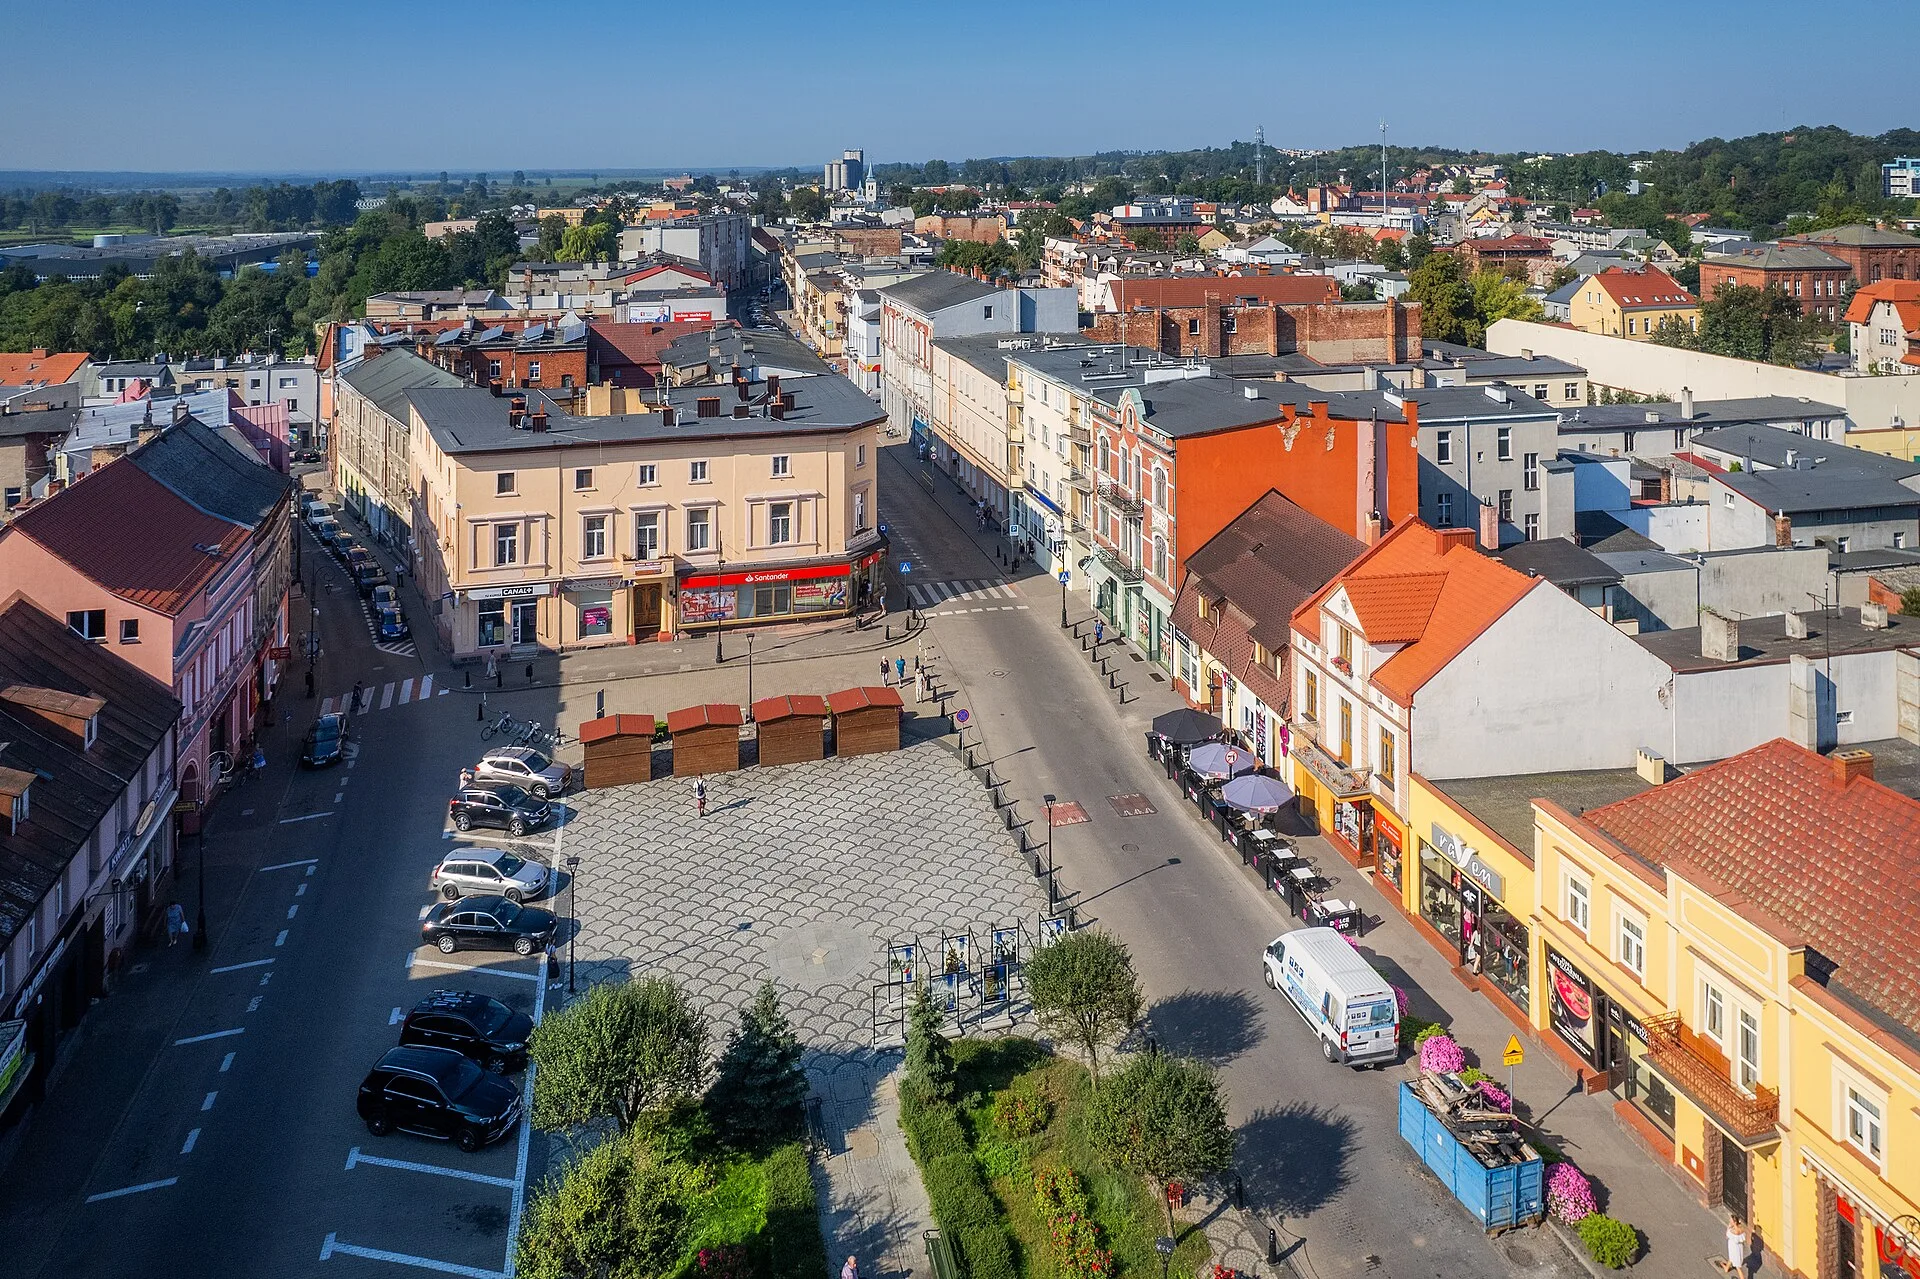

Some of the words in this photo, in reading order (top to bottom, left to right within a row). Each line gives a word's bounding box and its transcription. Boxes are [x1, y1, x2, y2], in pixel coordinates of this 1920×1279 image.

[754, 572, 789, 582] Santander
[503, 588, 532, 596] CANAL+
[1462, 889, 1477, 904] 4F
[1330, 916, 1350, 926] DOLCE
